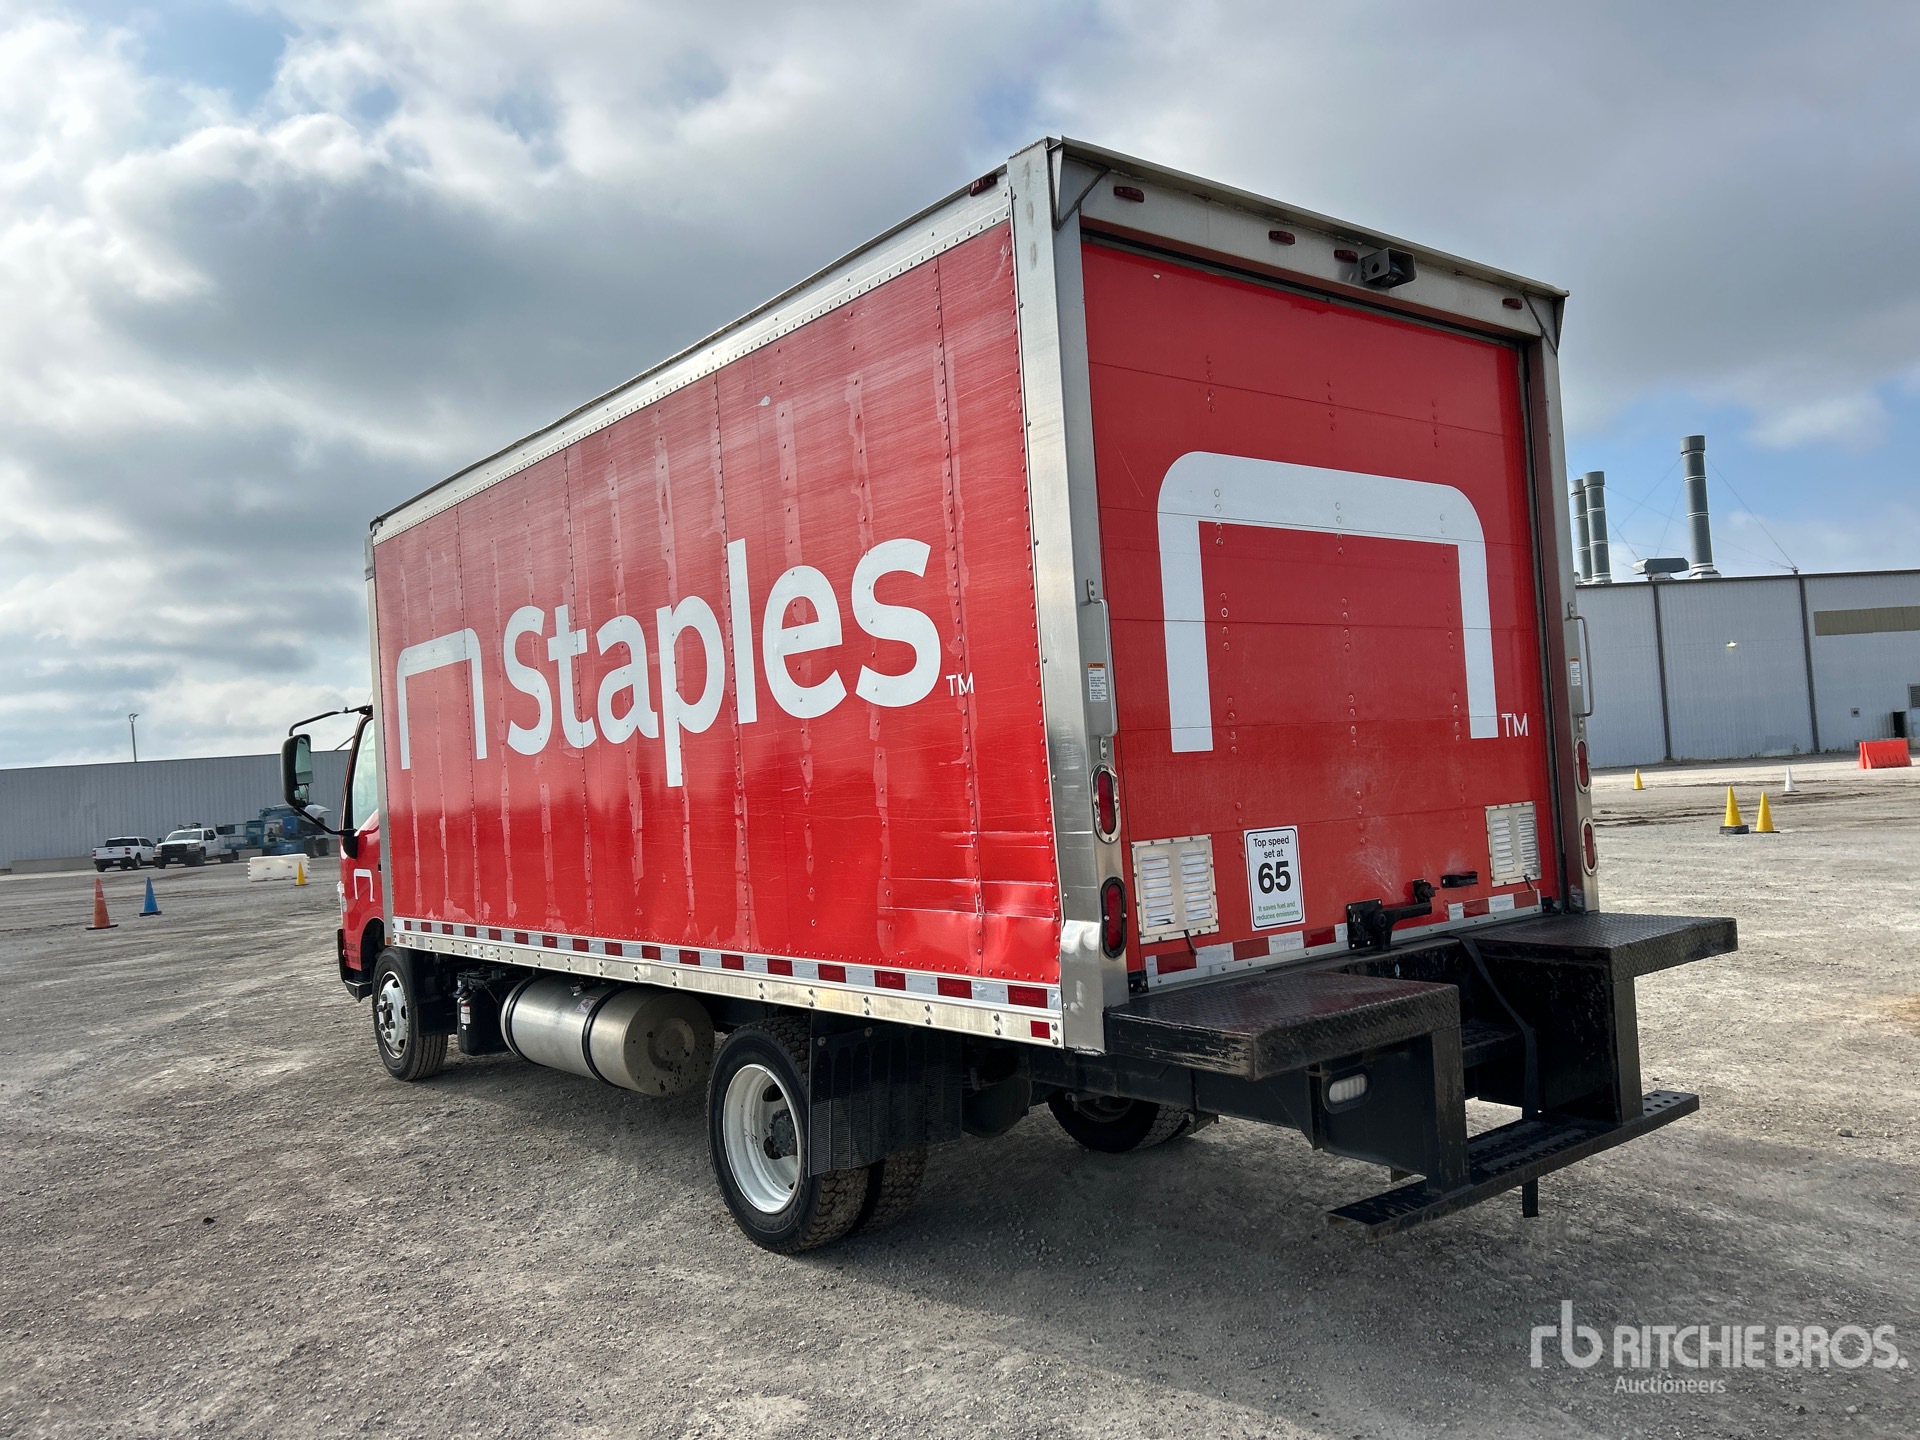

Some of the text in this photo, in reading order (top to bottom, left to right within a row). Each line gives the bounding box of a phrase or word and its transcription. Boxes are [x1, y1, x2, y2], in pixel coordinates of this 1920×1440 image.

[503, 538, 975, 787] Staples TM
[1501, 713, 1529, 738] TM
[1253, 835, 1290, 848] Top speed
[1263, 848, 1284, 859] set at
[1257, 860, 1292, 894] 65
[1286, 900, 1296, 908] and
